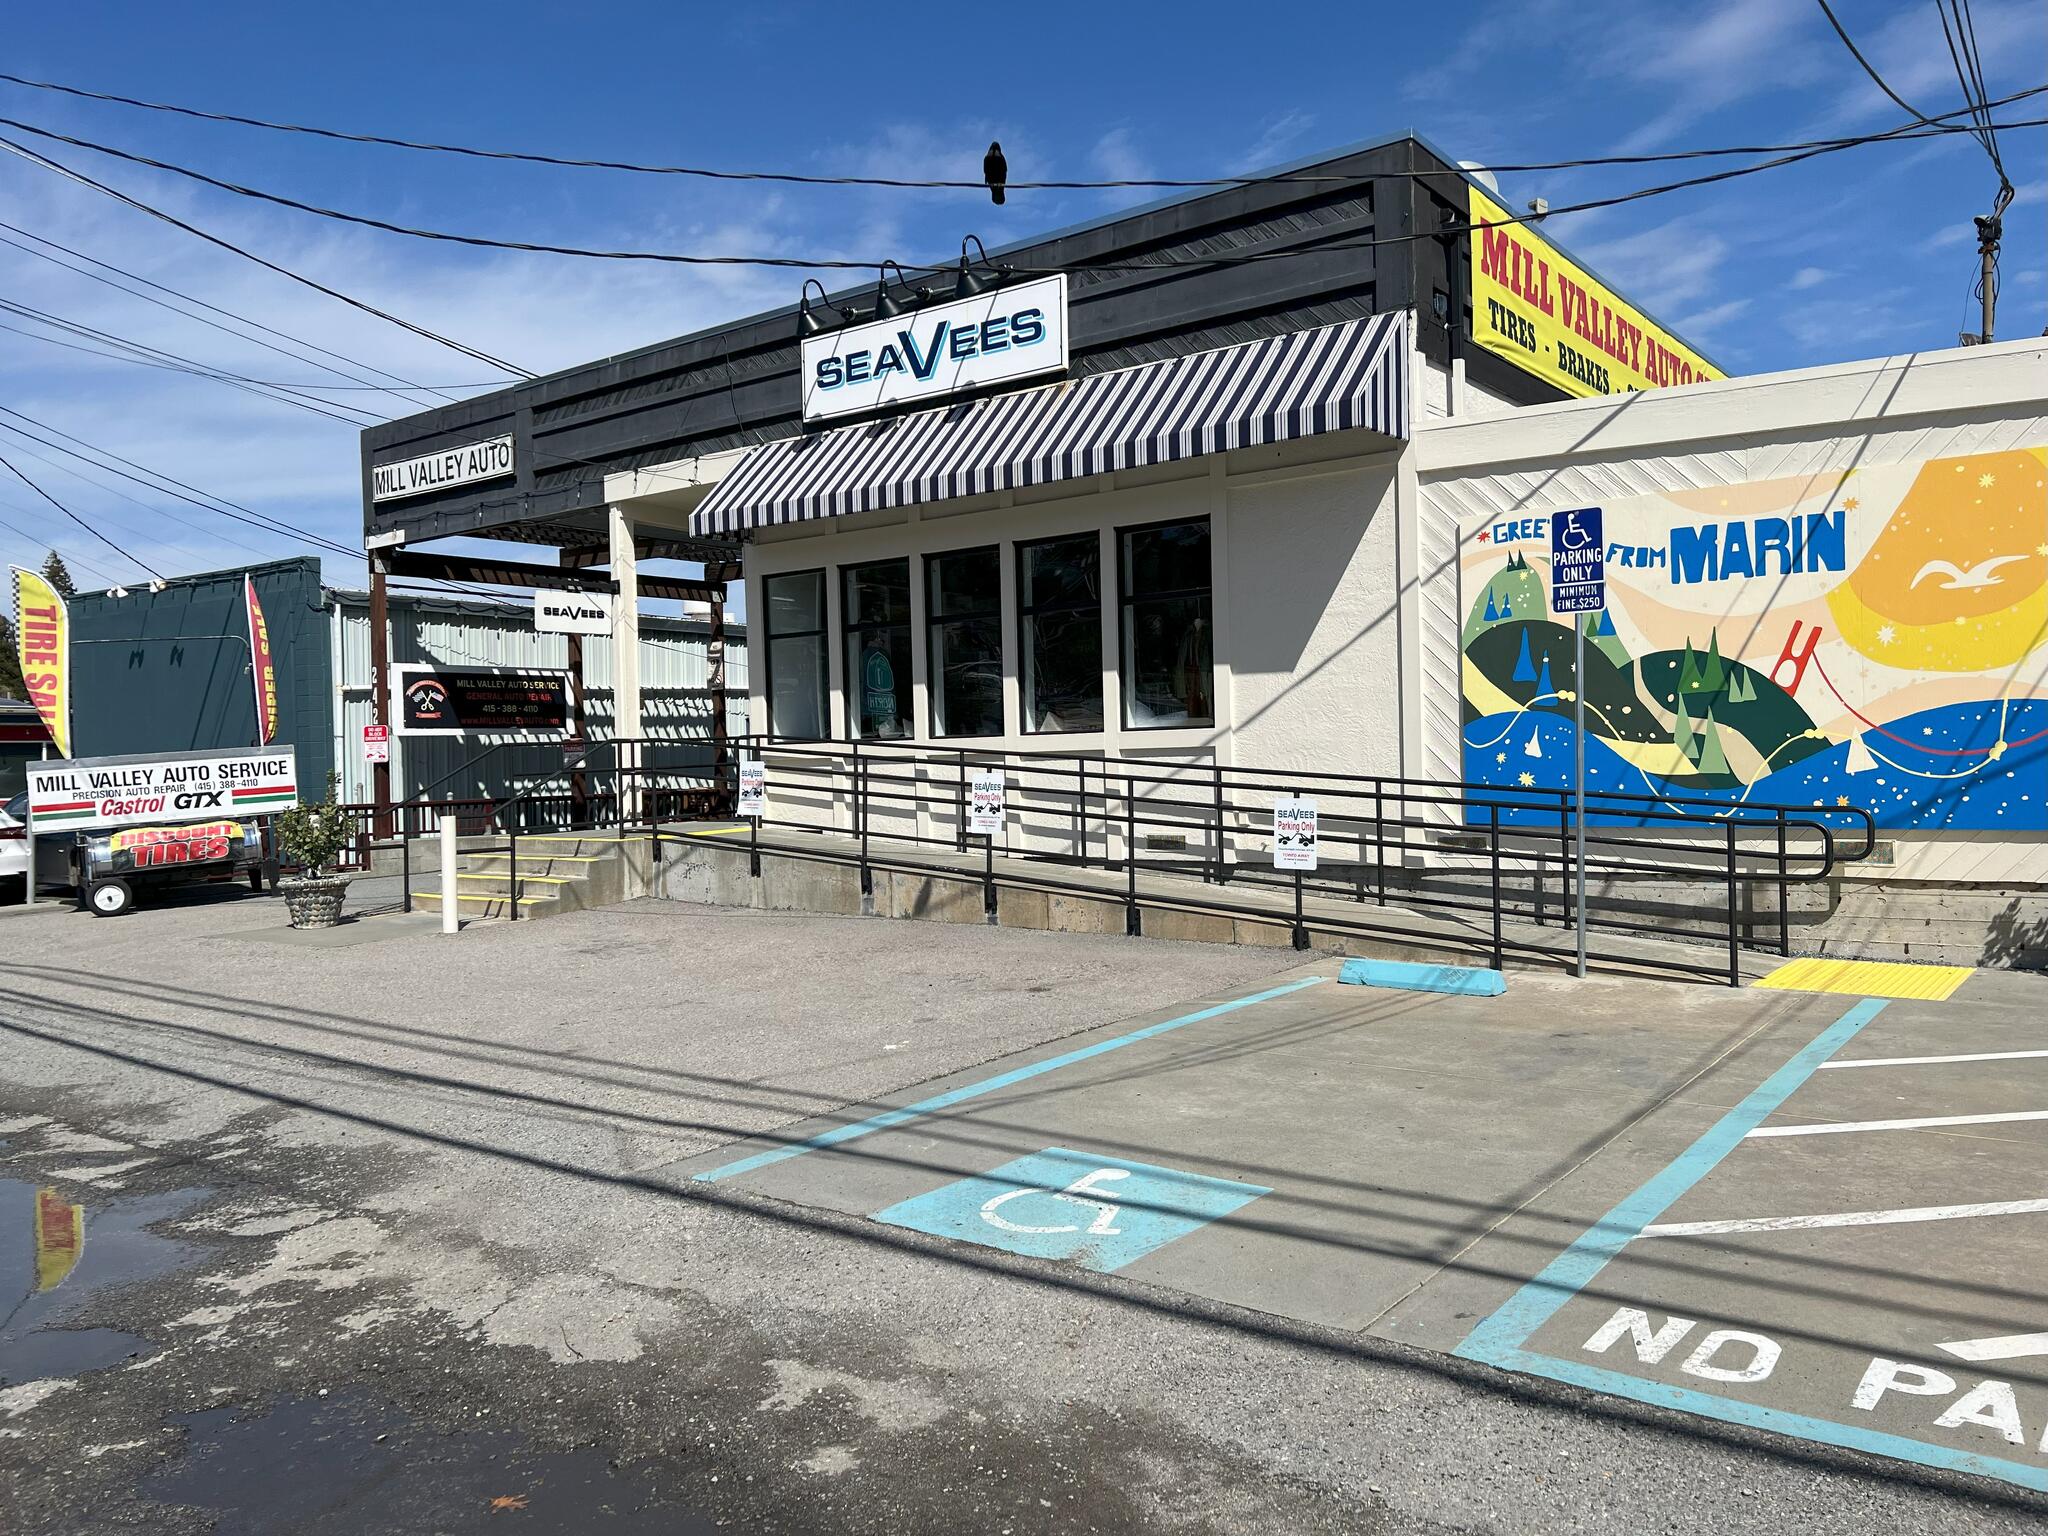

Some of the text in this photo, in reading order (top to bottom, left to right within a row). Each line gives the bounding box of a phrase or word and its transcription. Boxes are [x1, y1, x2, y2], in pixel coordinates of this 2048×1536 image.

[1480, 216, 1554, 318] MILL
[1558, 272, 1642, 374] VALLEY
[816, 307, 1046, 391] SEAVEES
[1487, 297, 1537, 354] TIRES
[1557, 340, 1609, 395] BRAKES
[375, 442, 509, 495] MILL VALLEY AUTO
[1553, 547, 1602, 567] PARKING
[1605, 510, 1847, 585] FROM MARIN
[1562, 565, 1593, 582] ONLY
[1559, 585, 1598, 597] MINIMUM
[543, 605, 605, 621] SEAVEES
[1557, 597, 1600, 610] FINE $250
[25, 605, 57, 665] TIRE
[456, 679, 560, 690] MILL VALLEY AUTO SERVICE
[36, 760, 288, 793] MILL VALLEY AUTO SERVICE
[974, 781, 1002, 792] SEAVEES
[72, 778, 258, 800] PRECISION AUTO REPAIR (415) 388-4110
[974, 792, 990, 802] Parking
[101, 791, 225, 817] Castrol GTX
[1277, 808, 1315, 821] SEAVEES
[120, 824, 232, 846] DISCOUNT
[1277, 821, 1315, 833] Parking Only
[131, 837, 229, 868] TIRES
[1581, 1306, 1782, 1383] NO
[1850, 1357, 2048, 1454] PA
